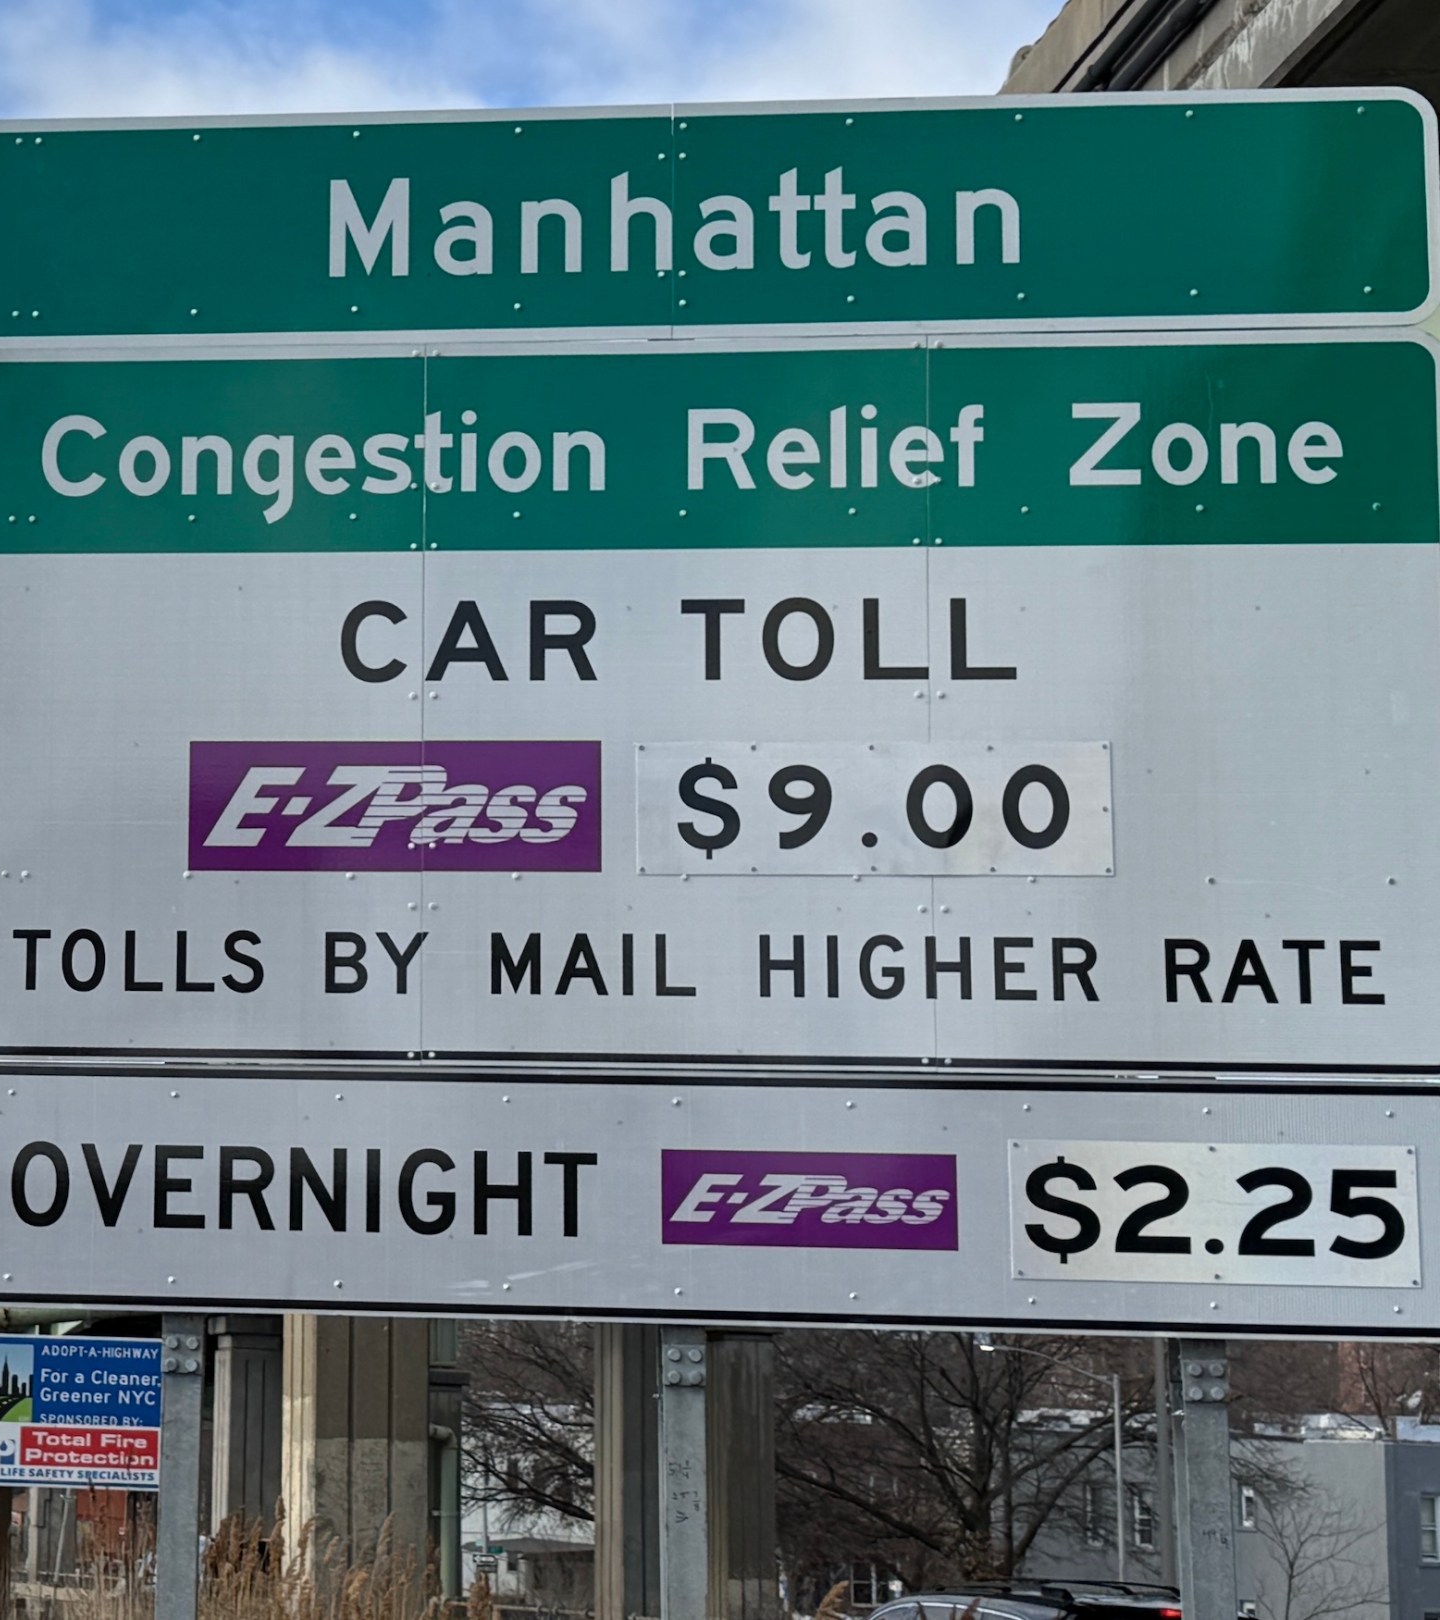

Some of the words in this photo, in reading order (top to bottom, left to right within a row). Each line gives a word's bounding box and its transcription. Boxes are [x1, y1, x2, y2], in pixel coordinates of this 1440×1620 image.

[328, 167, 1021, 278] Manhattan
[41, 410, 606, 525] Congestion
[686, 403, 985, 491] Relief
[1068, 402, 1344, 487] Zone
[339, 600, 598, 683] CAR
[680, 597, 1017, 682] TOLL
[676, 757, 1071, 860] $9.00
[12, 928, 265, 994] TOLLS
[324, 931, 429, 995] BY
[490, 932, 697, 997] MAIL
[759, 934, 1100, 1002] HIGHER
[1164, 938, 1386, 1005] RATE
[10, 1140, 598, 1238] OVERNIGHT
[1024, 1155, 1406, 1265] $2.25
[41, 1345, 158, 1359] ADOPT-A-HIGHWAY
[40, 1368, 69, 1383] For
[74, 1372, 85, 1384] a
[39, 1387, 111, 1404] Greener
[118, 1390, 156, 1406] NYC
[40, 1413, 117, 1425] SPONSORED
[31, 1431, 91, 1447] Total
[100, 1433, 148, 1449] Fire
[25, 1447, 154, 1466] Protection
[0, 1467, 25, 1477] LIFE
[28, 1468, 74, 1479] SAFETY
[77, 1470, 155, 1481] SPECIALISTS
